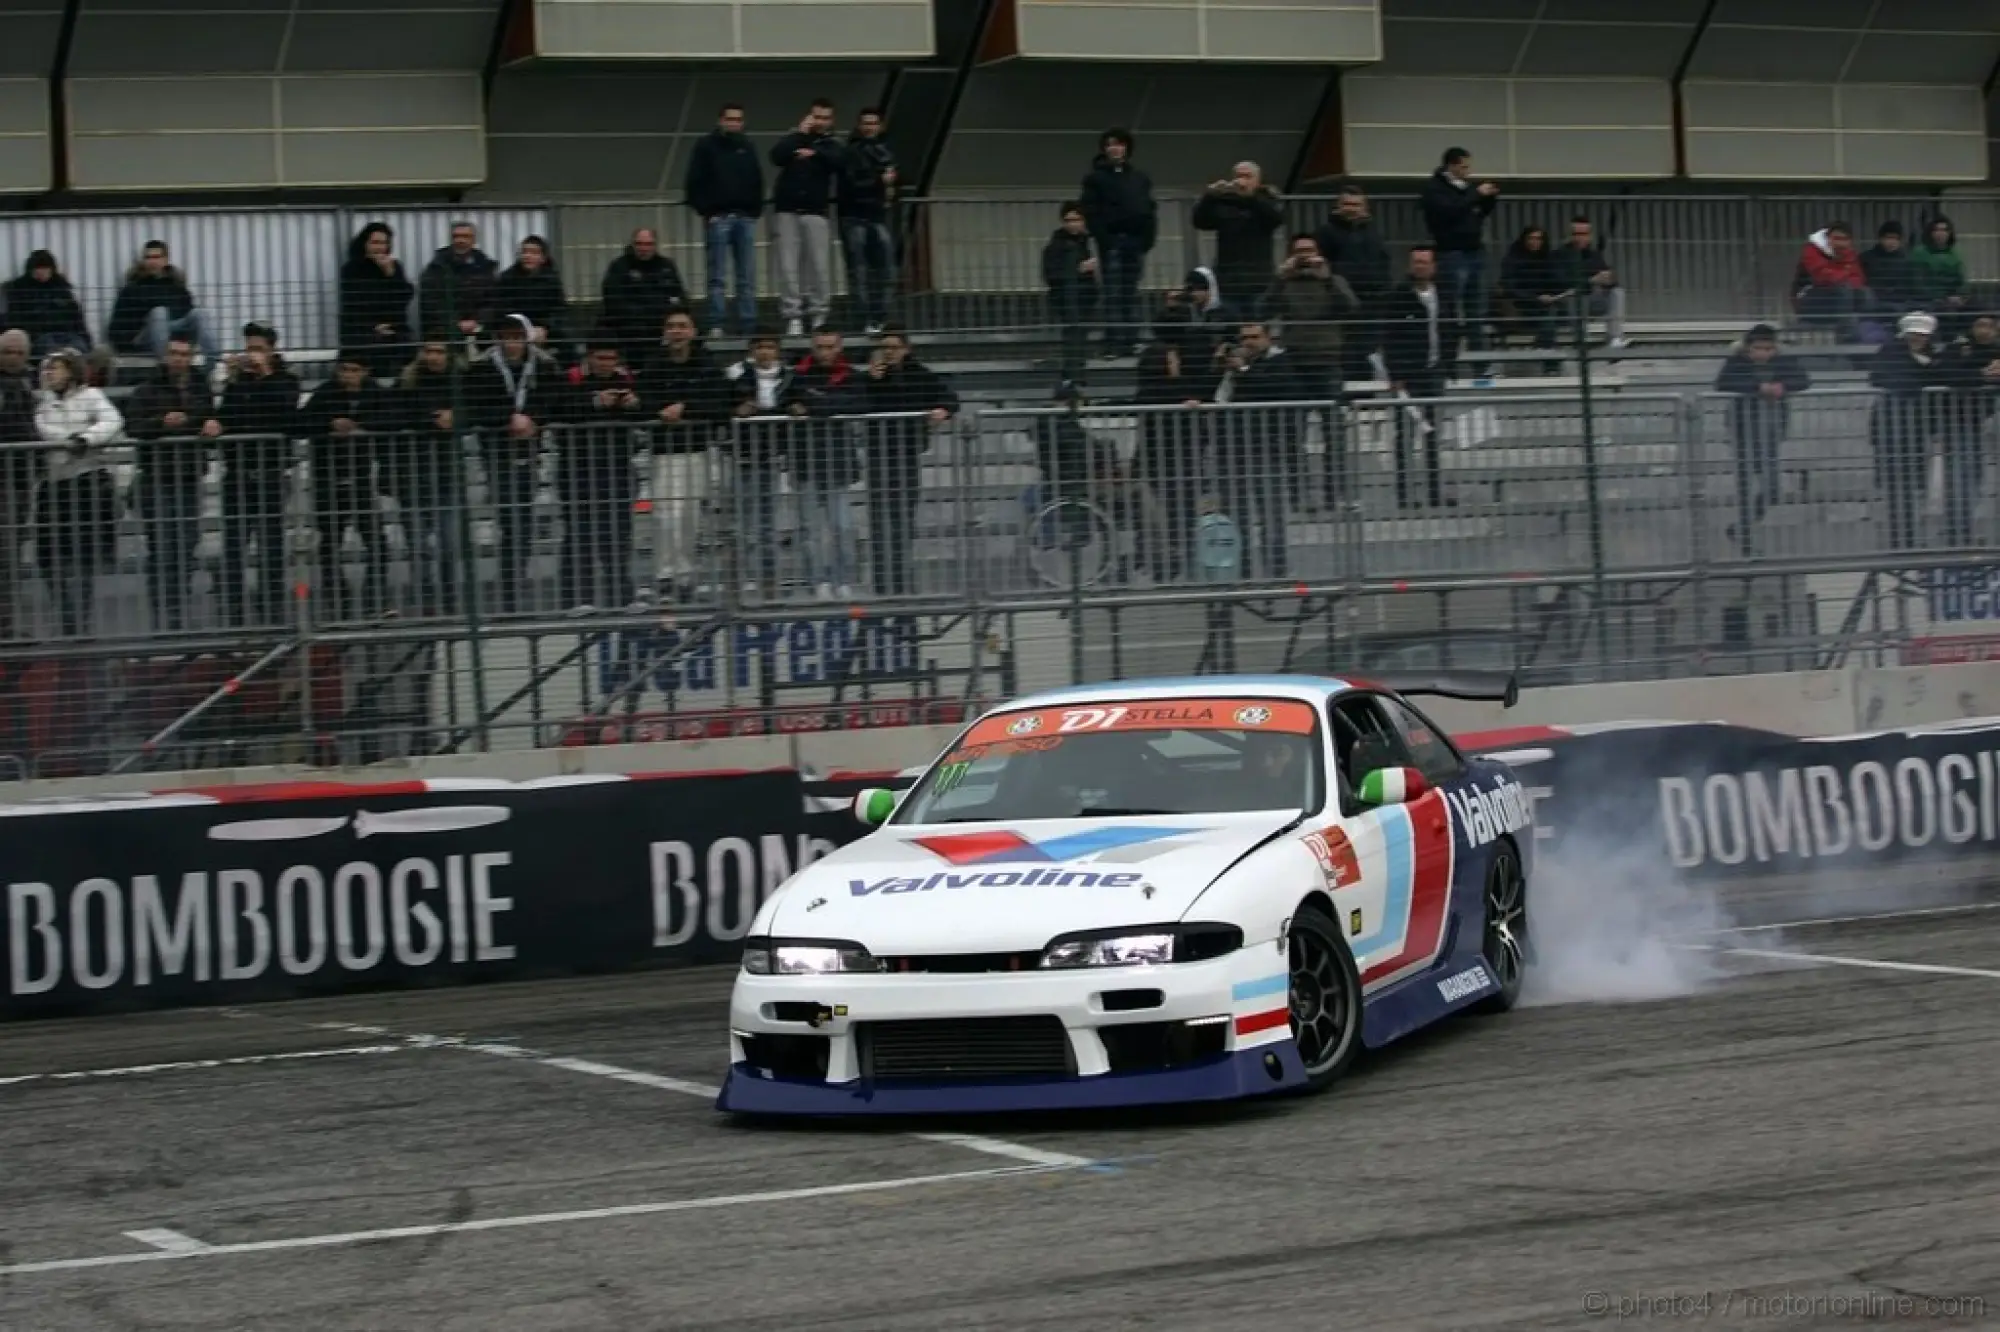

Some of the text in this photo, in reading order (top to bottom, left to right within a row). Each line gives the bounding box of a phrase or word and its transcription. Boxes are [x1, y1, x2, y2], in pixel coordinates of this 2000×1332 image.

[1659, 750, 2000, 868] BOMBOOGI
[8, 851, 516, 995] BOMBOOGIE
[849, 868, 1143, 897] Valvoline
